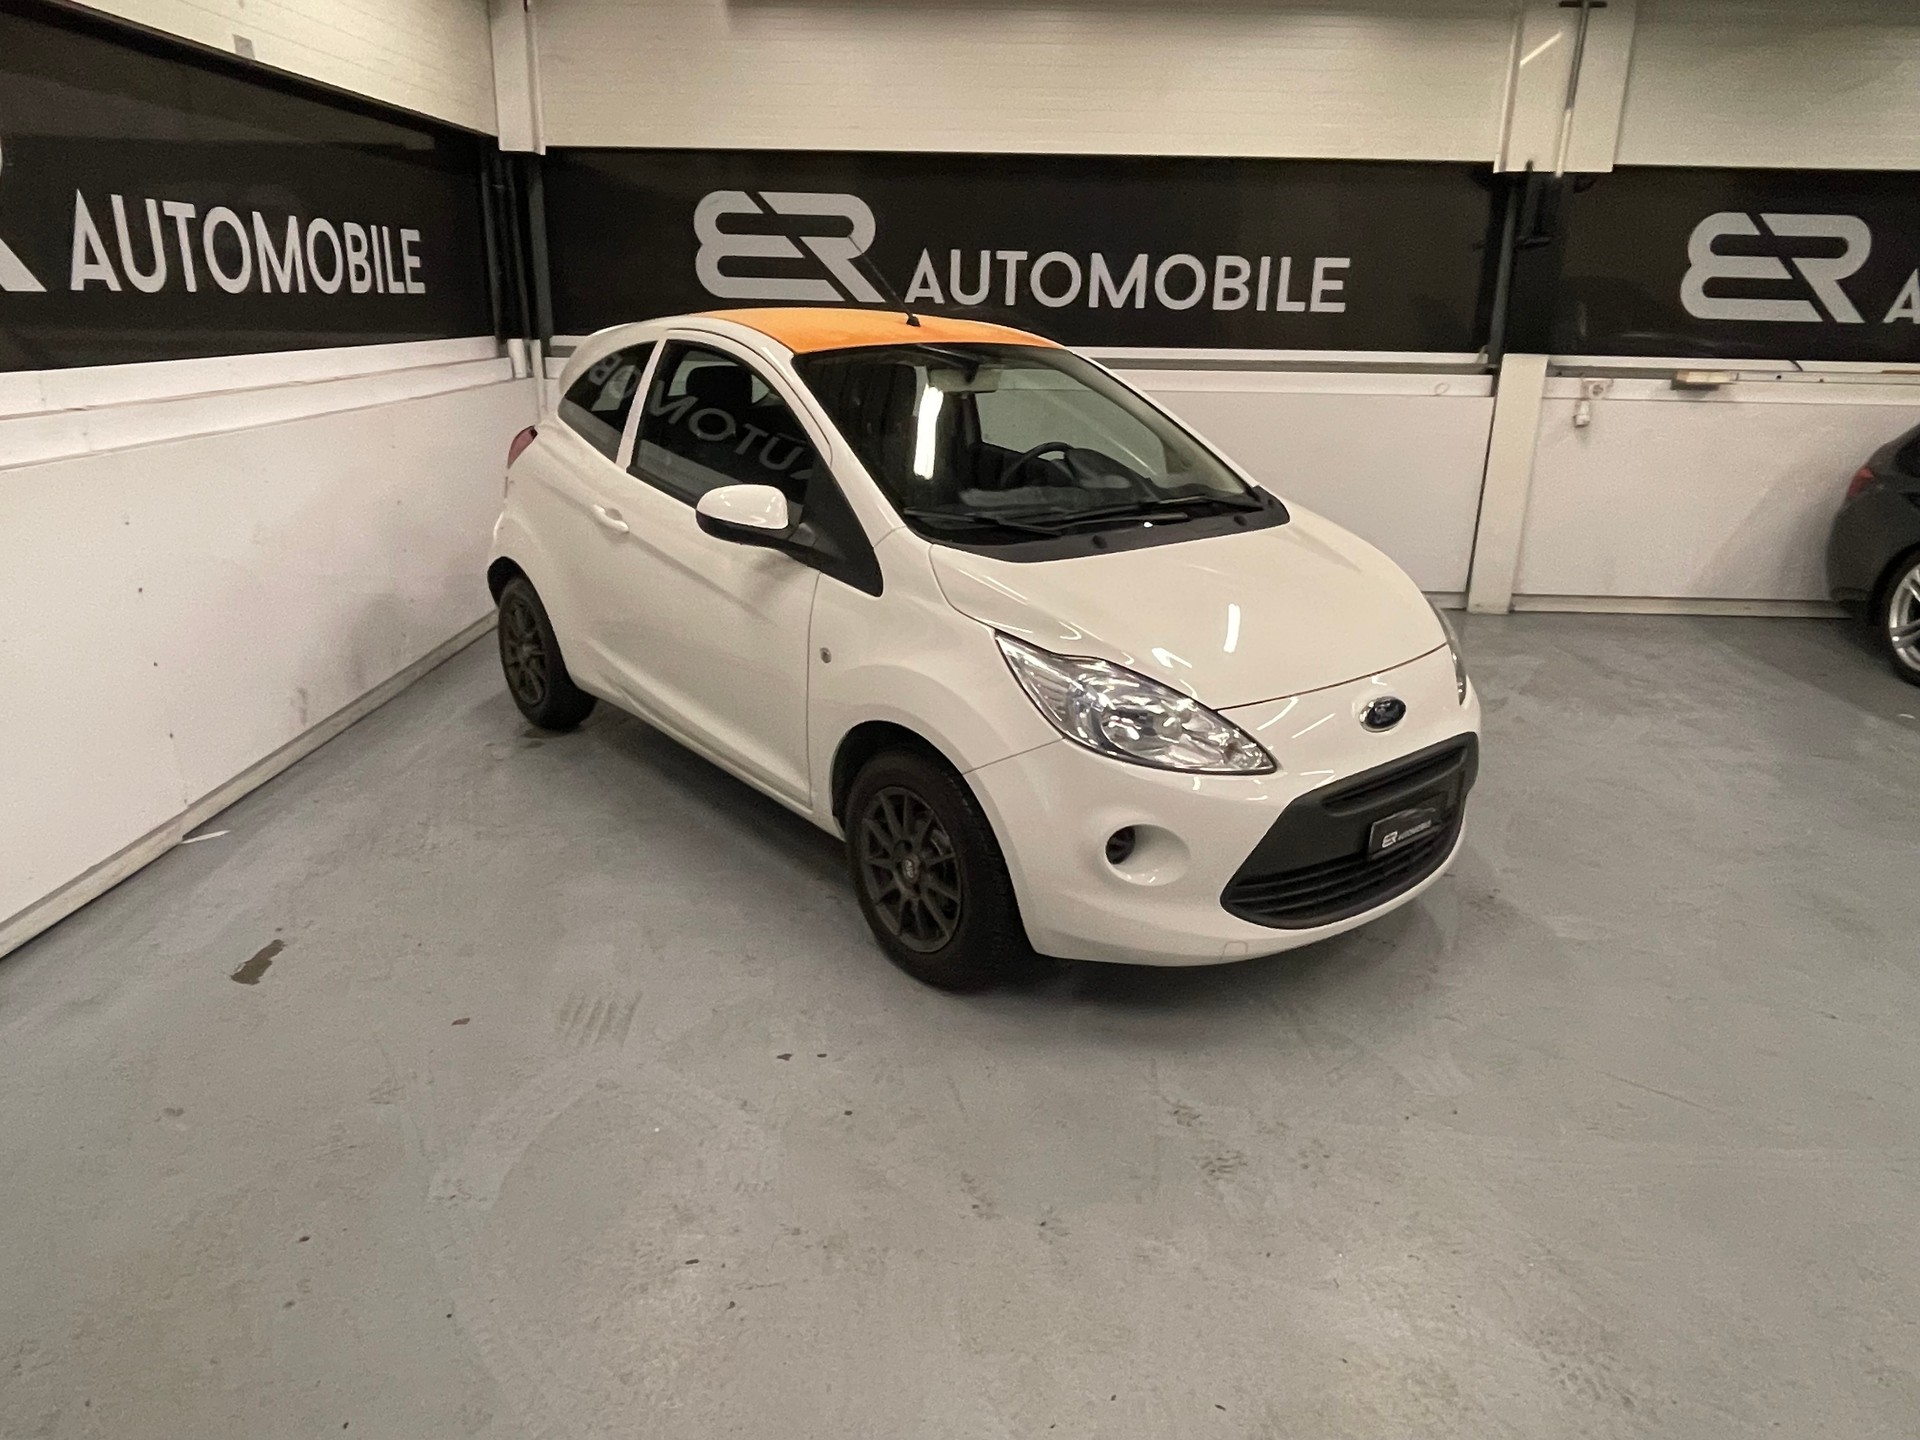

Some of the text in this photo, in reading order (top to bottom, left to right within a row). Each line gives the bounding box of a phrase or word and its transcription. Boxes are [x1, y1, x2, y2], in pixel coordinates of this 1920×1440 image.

[71, 189, 425, 294] AUTOMOBILE
[694, 191, 1350, 312] ER AUTOMOBILE
[1681, 213, 1871, 323] ER
